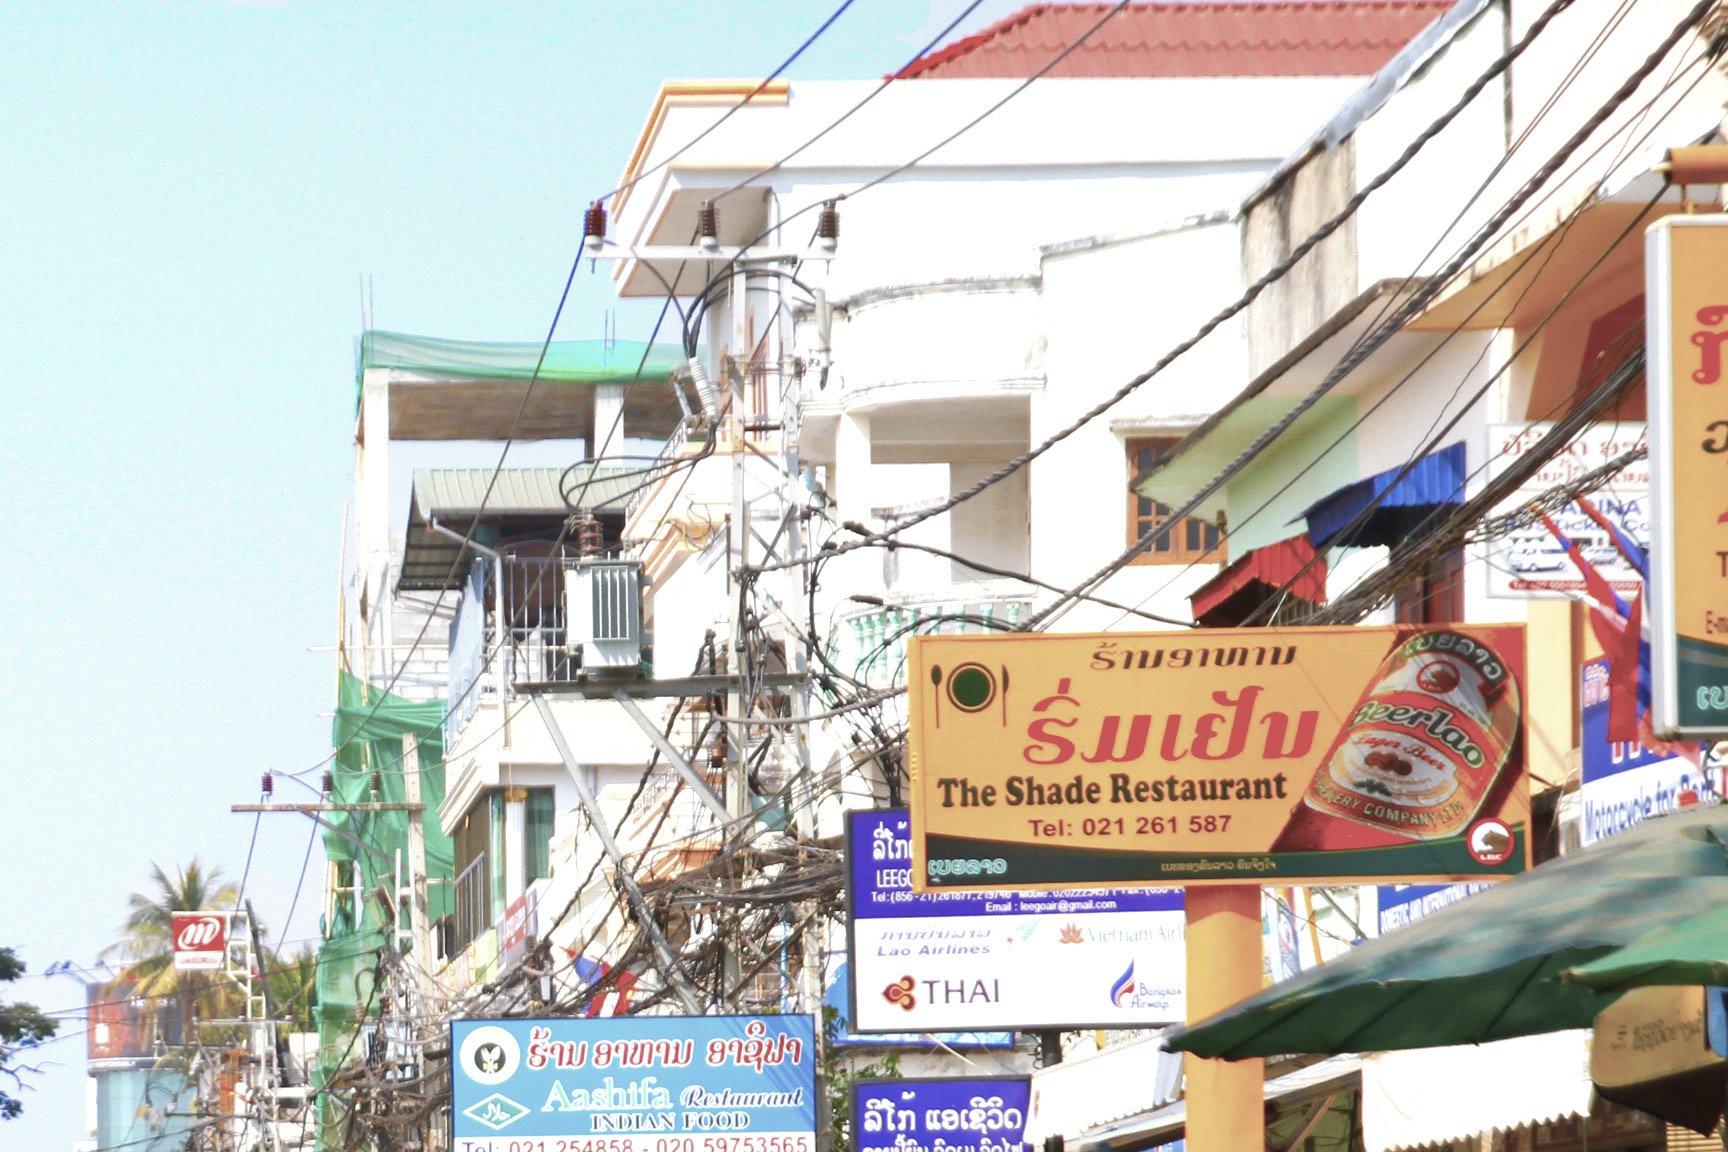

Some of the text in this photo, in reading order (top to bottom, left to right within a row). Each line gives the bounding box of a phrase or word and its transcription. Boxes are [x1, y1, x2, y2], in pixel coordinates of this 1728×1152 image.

[1350, 700, 1485, 768] Beerlao
[1403, 743, 1446, 772] Beer
[938, 770, 1287, 808] The Shade Restaurant
[1363, 802, 1439, 826] COMPANY
[1029, 815, 1232, 838] Tel: 021 261 587
[986, 902, 1011, 912] Email
[1020, 900, 1116, 913] leegoair@gmail.com
[1087, 927, 1153, 942] Vietnam
[877, 944, 991, 956] Lao Airlines
[922, 979, 1000, 1005] THAI
[1139, 982, 1182, 999] Bangkok
[541, 1078, 803, 1112] Aashifa Restaurant
[591, 1113, 749, 1131] INDIAN FOOD
